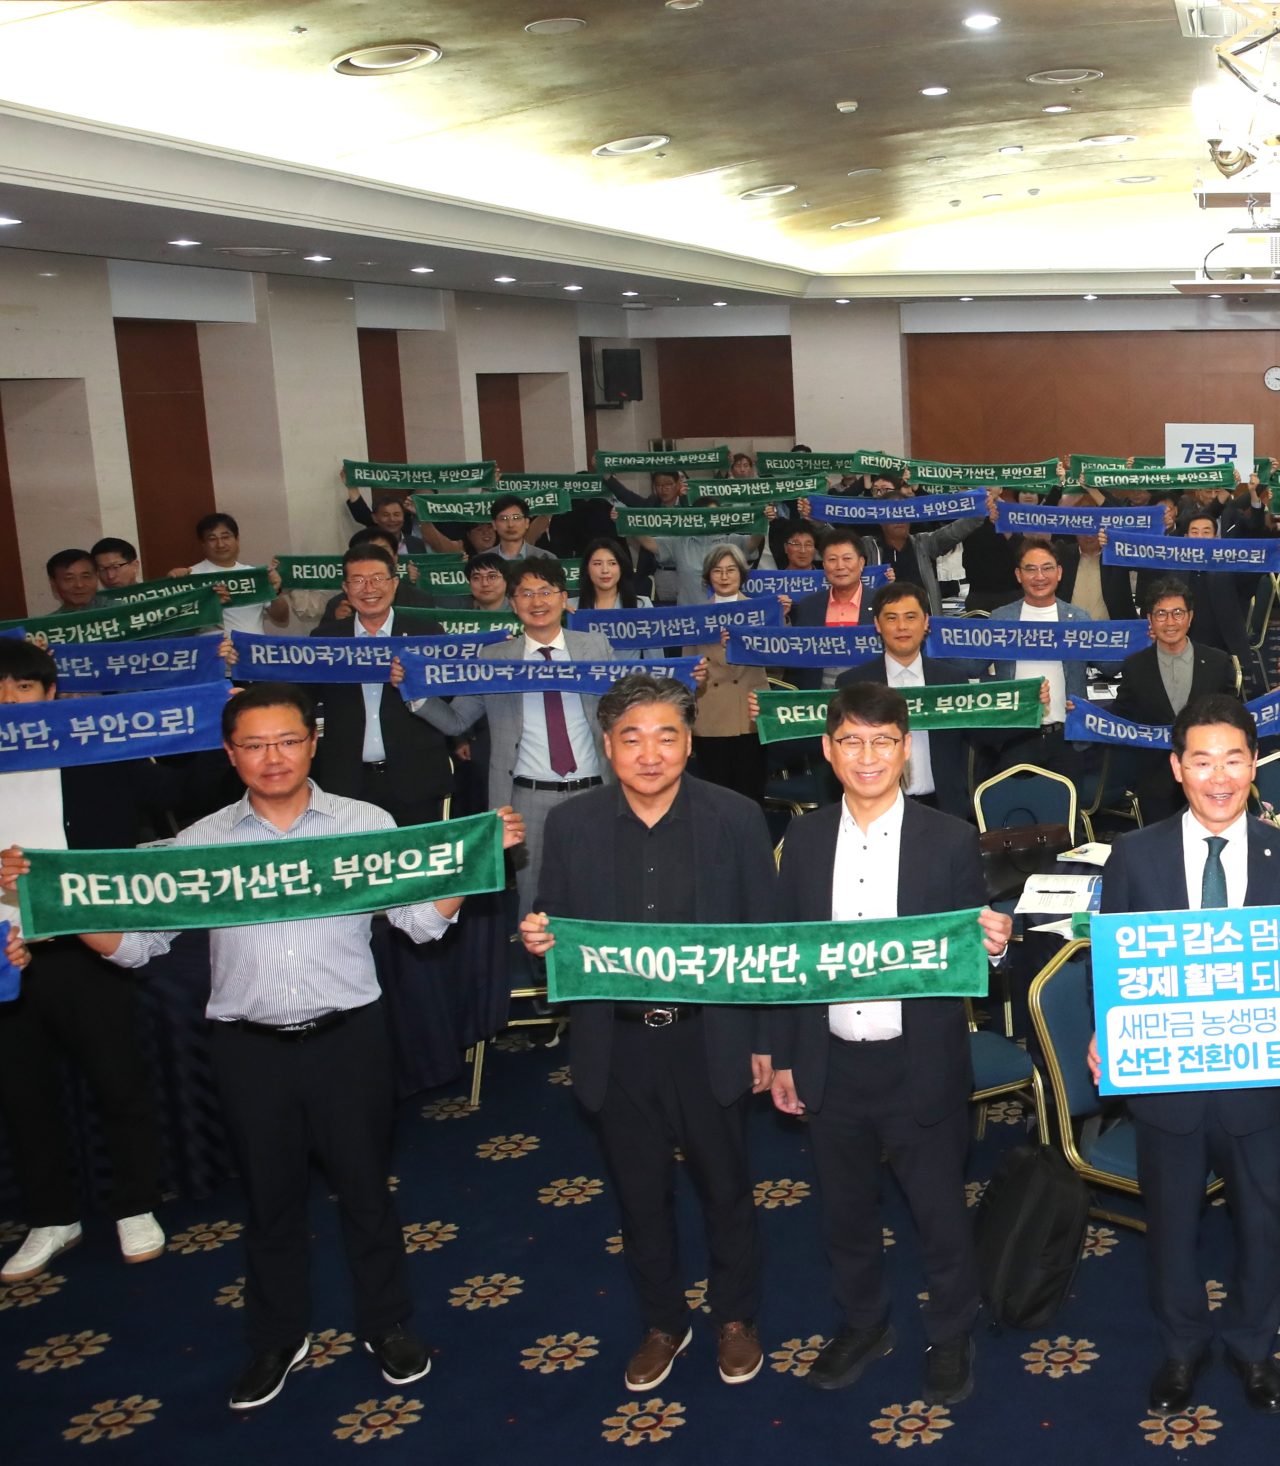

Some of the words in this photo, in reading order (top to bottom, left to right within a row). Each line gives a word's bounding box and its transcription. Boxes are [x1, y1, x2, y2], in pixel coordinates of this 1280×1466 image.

[1181, 443, 1238, 464] 7공구
[354, 468, 437, 484] RE100국가산단,
[438, 467, 485, 482] 부안으로!
[917, 466, 999, 481] RE100국가산단,
[1001, 465, 1047, 480] 부안으로!
[1177, 470, 1223, 483] 부안으로!
[563, 480, 603, 493] 부안으로!
[698, 480, 774, 497] RE100국가산단,
[774, 478, 818, 492] 부안으로!
[524, 493, 559, 510] 안으로!
[824, 503, 921, 520] RE100국가산단,
[922, 496, 976, 518] 부안으로!
[627, 514, 707, 529] RE100국가산단,
[709, 512, 755, 527] 부안으로!
[1008, 511, 1099, 531] RE100국가산단,
[1100, 514, 1152, 529] 부안으로!
[1114, 541, 1209, 565] RE100국가산단,
[1211, 548, 1266, 564] 부안으로!
[129, 601, 200, 631] 부안으로!
[941, 627, 1058, 649] RE100국가산단,
[1062, 630, 1130, 650] 부안으로!
[106, 649, 199, 677] 부안으로!
[251, 644, 393, 666] RE100국가산단
[935, 690, 1020, 715] 부안으로!
[69, 706, 196, 746] 부안으로!
[59, 858, 323, 907] RE100국가산단,
[331, 840, 465, 885] 부안으로!
[1115, 923, 1177, 959] 인구
[1182, 921, 1244, 956] 감소
[581, 942, 808, 986] RE100국가산단,
[815, 937, 949, 978] 부안으로!
[1117, 965, 1179, 1000] 경제
[1184, 961, 1245, 997] 활력
[1118, 1011, 1195, 1041] 새만금
[1201, 1006, 1277, 1037] 농생명
[1116, 1046, 1171, 1077] 산단
[1178, 1041, 1260, 1074] 전환이
